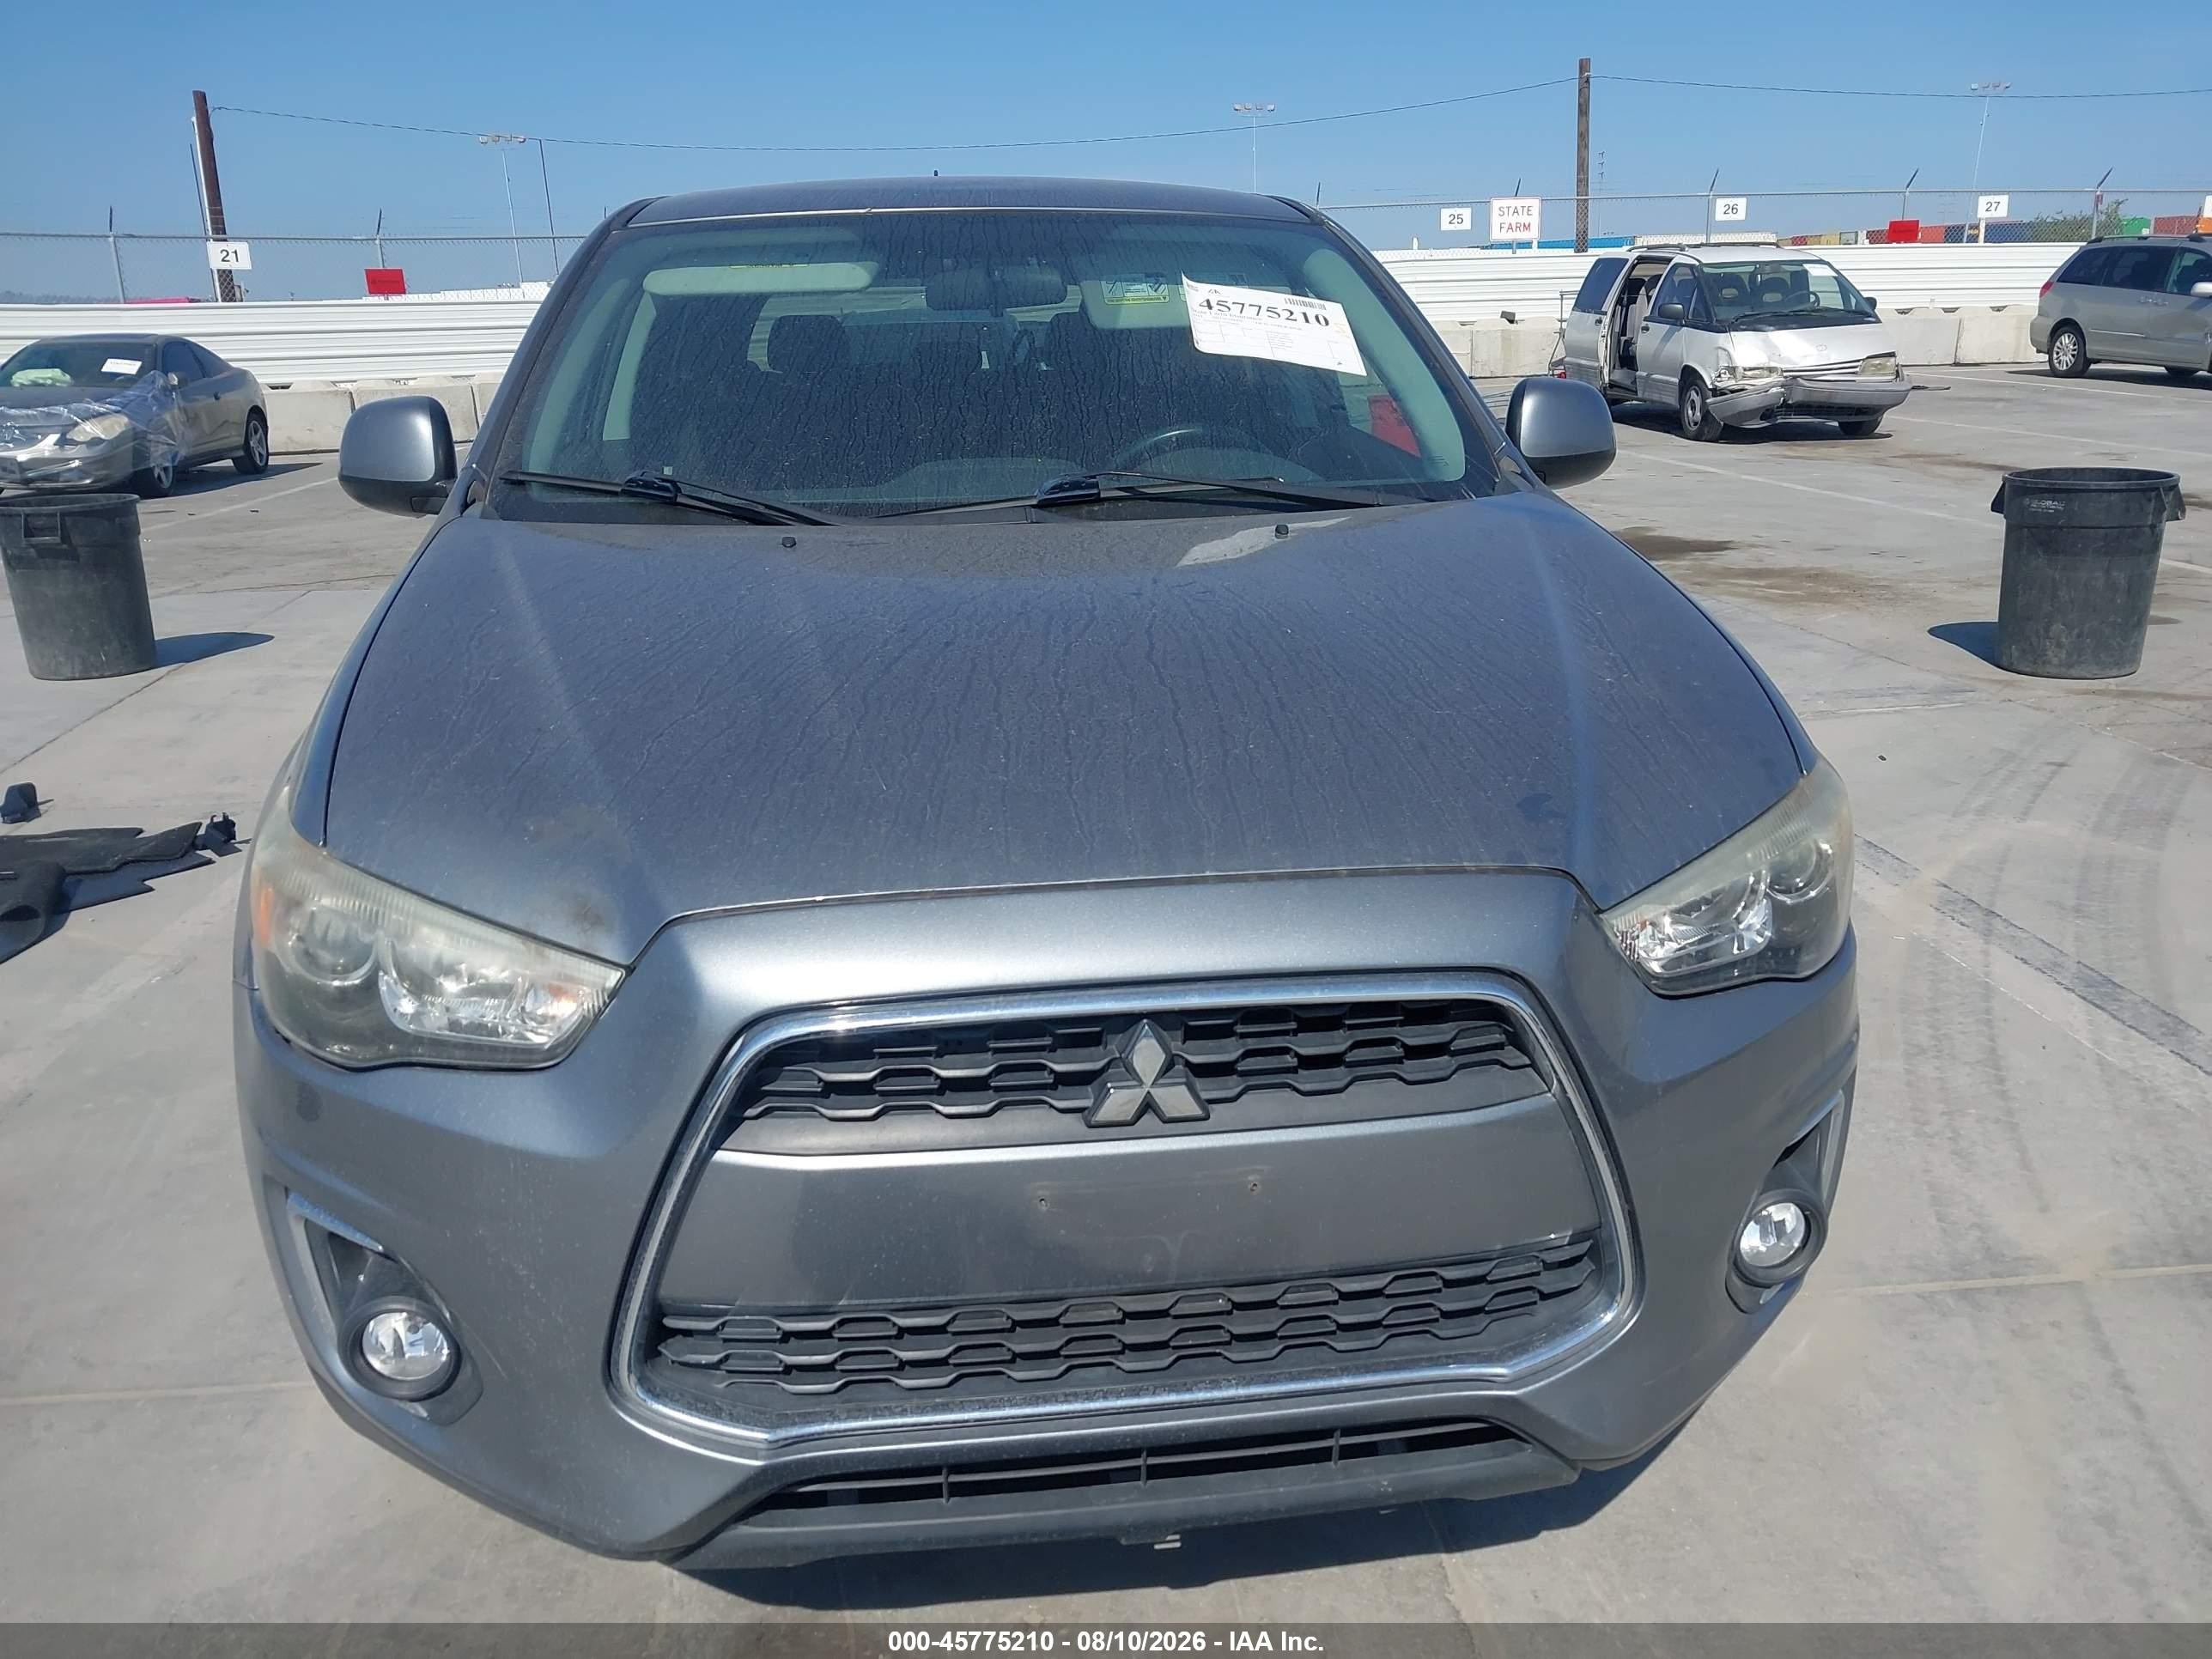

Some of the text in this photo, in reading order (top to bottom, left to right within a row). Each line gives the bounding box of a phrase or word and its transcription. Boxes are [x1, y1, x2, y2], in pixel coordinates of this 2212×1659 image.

[1498, 206, 1533, 216] STATE
[1723, 204, 1739, 215] 26
[1985, 201, 2001, 212] 27
[1449, 214, 1464, 224] 25
[1499, 222, 1531, 233] FARM
[220, 249, 239, 262] 21
[1199, 298, 1330, 327] 45775210
